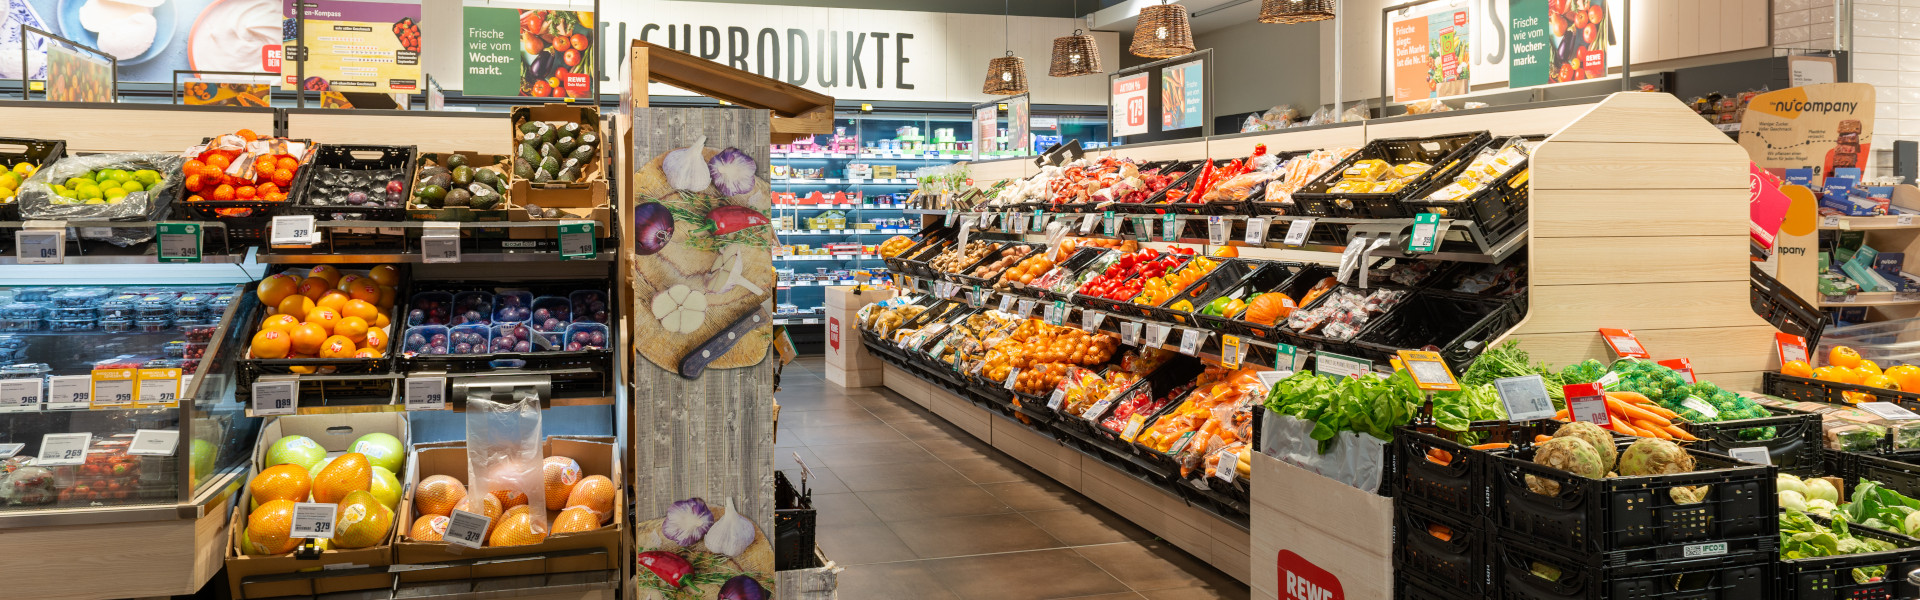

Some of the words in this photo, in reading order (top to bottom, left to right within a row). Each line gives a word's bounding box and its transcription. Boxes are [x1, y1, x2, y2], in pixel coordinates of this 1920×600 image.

[1513, 16, 1539, 29] Frische
[469, 28, 505, 39] Frische
[1395, 26, 1415, 36] Frische
[1513, 31, 1526, 41] wie
[1528, 29, 1544, 38] vom
[469, 40, 487, 50] wie
[490, 43, 512, 51] vom
[1396, 47, 1408, 57] Dein
[1409, 45, 1425, 54] Markt
[1513, 42, 1546, 54] Wochen-
[469, 52, 515, 63] Wochen-
[1513, 55, 1538, 66] markt.
[1586, 53, 1602, 61] REWE
[469, 65, 502, 75] markt.
[315, 521, 330, 532] 3.79
[1702, 544, 1719, 552] IFCO
